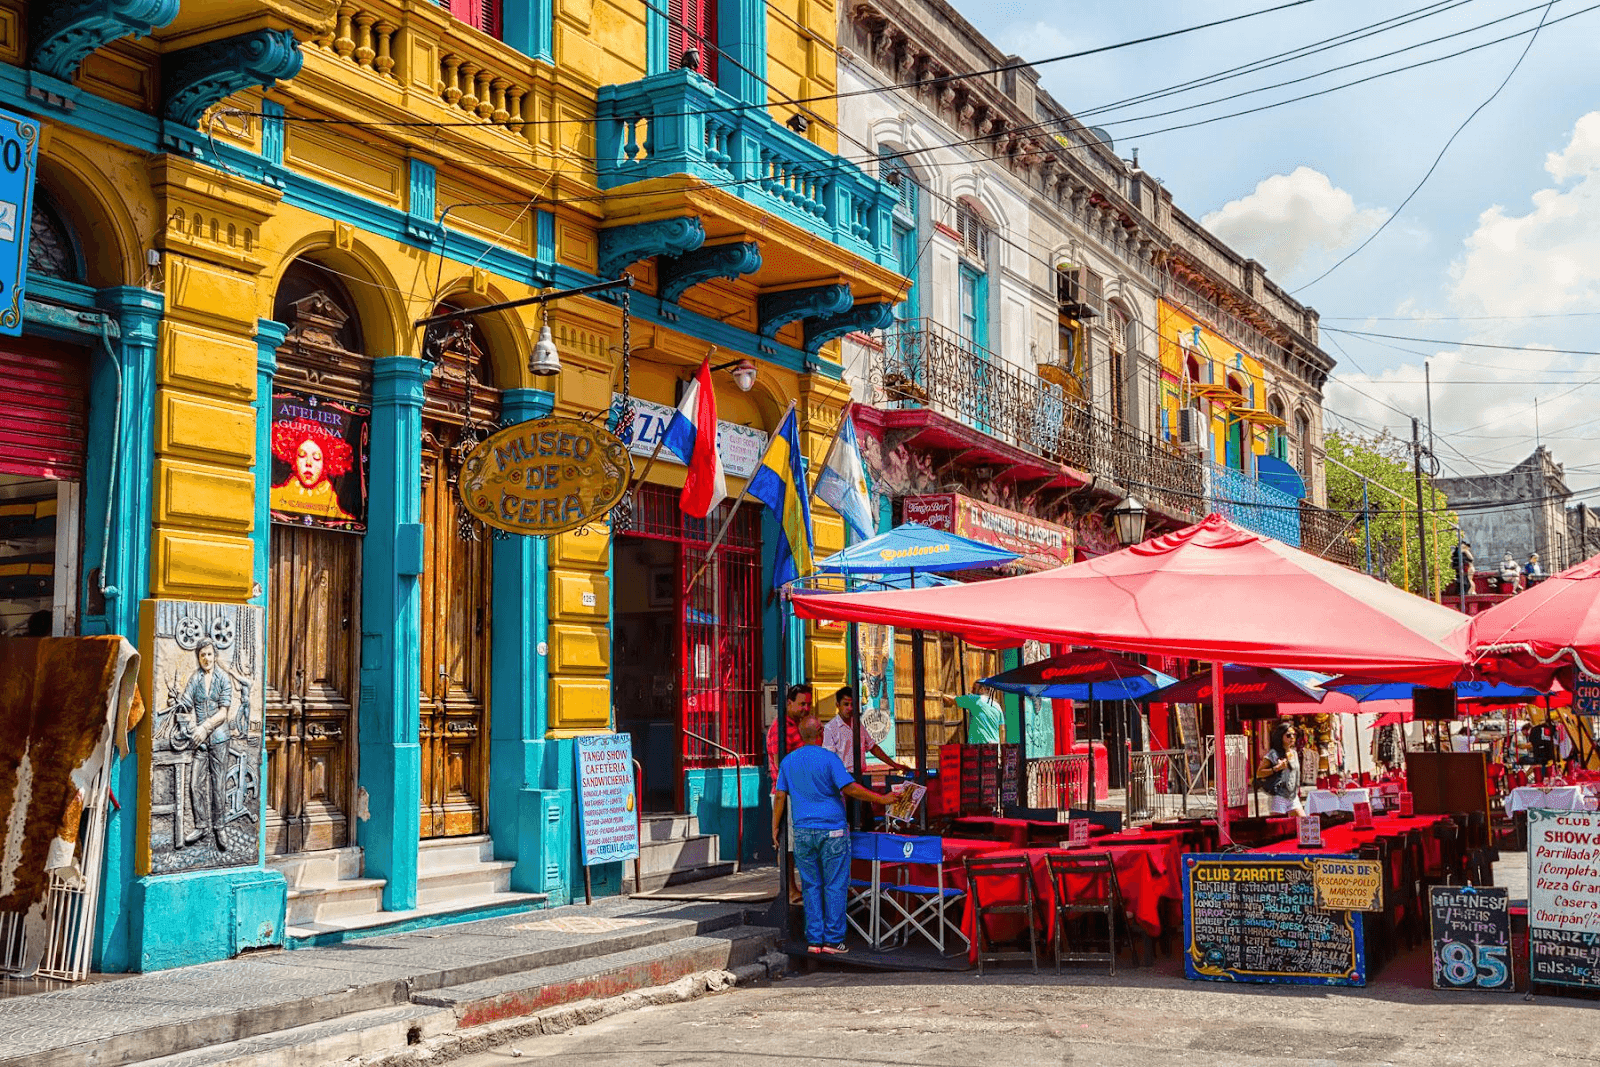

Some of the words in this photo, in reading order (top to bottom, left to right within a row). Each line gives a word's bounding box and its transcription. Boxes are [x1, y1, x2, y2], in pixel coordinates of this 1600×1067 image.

[279, 403, 343, 426] ATELIER
[494, 431, 592, 471] MUSEO
[526, 464, 560, 490] DE
[500, 488, 586, 524] CERA
[908, 502, 931, 515] Tango
[930, 502, 950, 512] Bar
[971, 505, 981, 526] EL
[981, 510, 1017, 538] SAMOVAR
[1018, 520, 1028, 541] DE
[880, 545, 951, 562] Quilmes
[583, 751, 605, 762] TANGO
[607, 750, 627, 761] SHOW
[585, 763, 626, 775] CAFETERIA
[1557, 817, 1591, 827] CLUB
[1544, 831, 1592, 845] SHOW
[1536, 846, 1591, 862] Parrillada
[1198, 868, 1231, 882] CLUB
[1232, 868, 1285, 882] ZARATE
[1322, 864, 1354, 875] SOPAS
[1357, 865, 1371, 876] DE
[1194, 881, 1238, 894] TORTILLA
[1353, 878, 1377, 887] POLLO
[1536, 877, 1569, 892] Pizza
[1329, 887, 1368, 898] MARISCOS
[1327, 898, 1368, 907] VEGETALES
[1432, 893, 1508, 912] MILANESA
[1554, 895, 1598, 911] Casera
[1194, 909, 1225, 919] ARROZ
[1536, 909, 1584, 929] Choripán
[1195, 926, 1235, 937] CAZUELA
[1533, 929, 1582, 944] ARROZ
[1532, 940, 1567, 957] TAPA
[1567, 945, 1591, 960] DE
